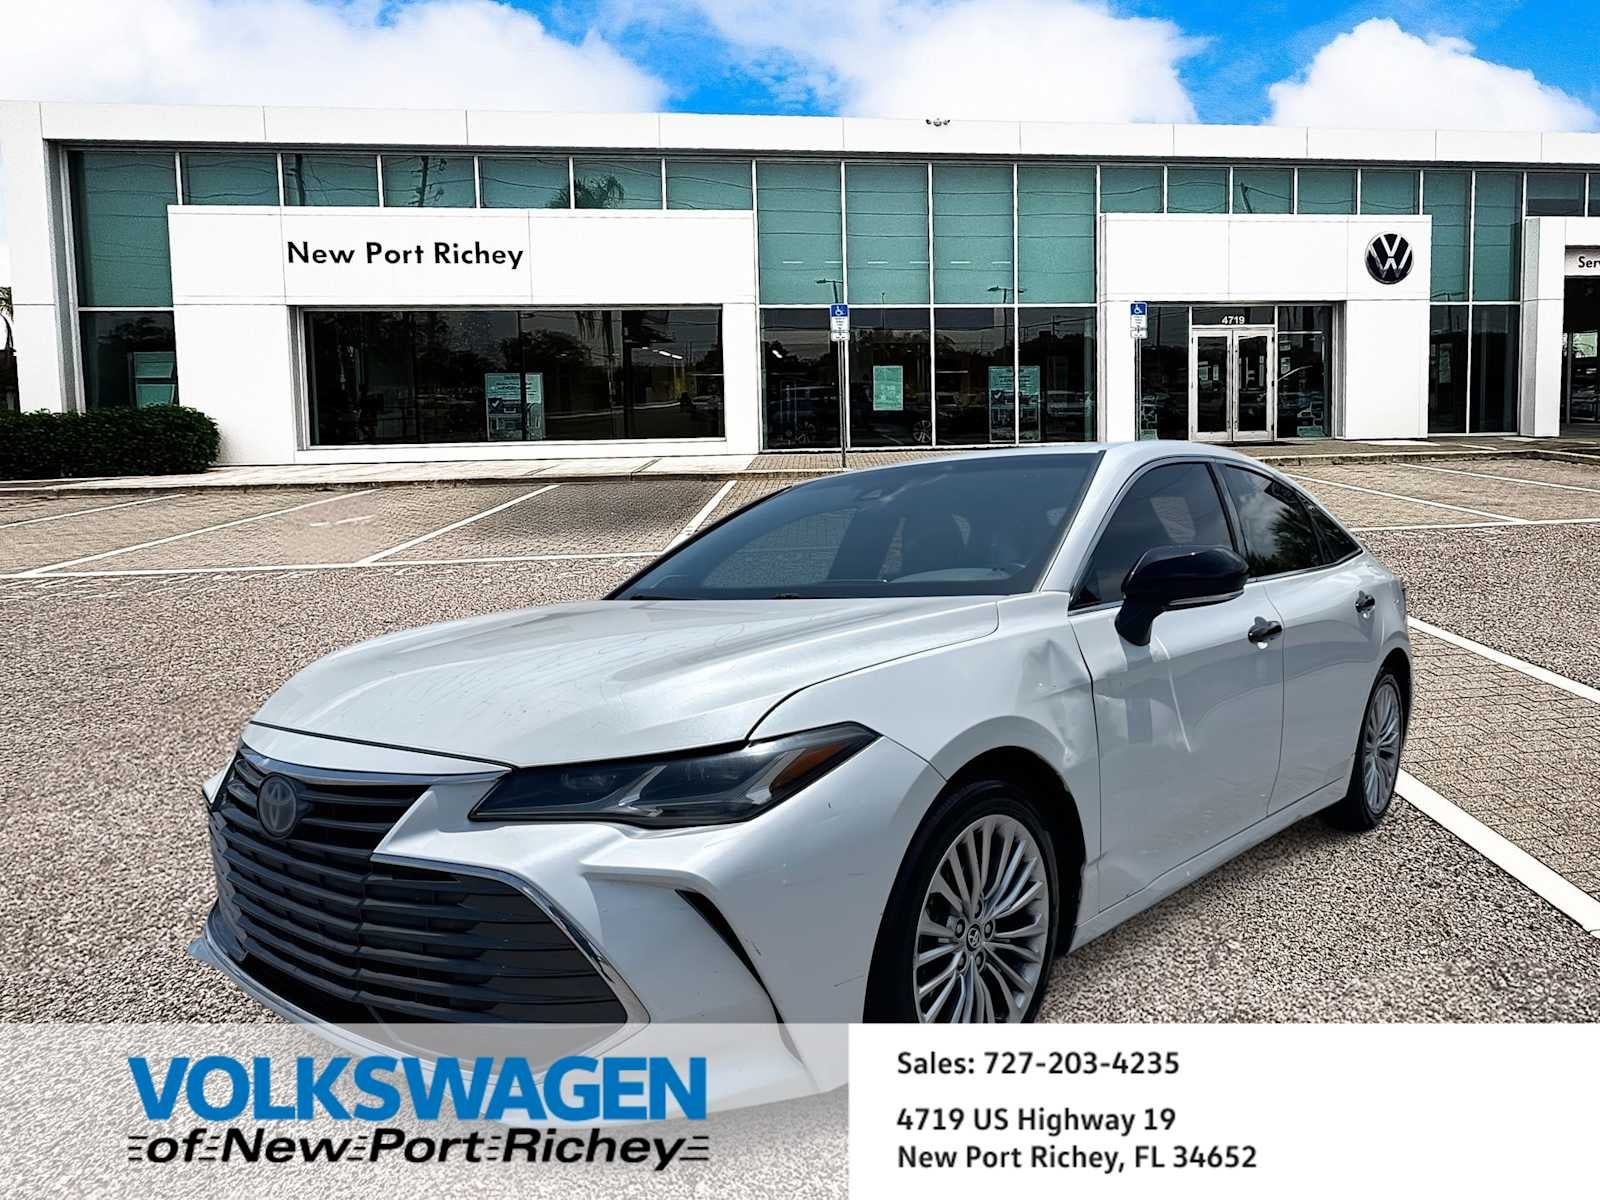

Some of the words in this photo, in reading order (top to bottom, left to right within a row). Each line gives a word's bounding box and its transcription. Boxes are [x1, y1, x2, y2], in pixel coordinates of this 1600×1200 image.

[287, 241, 356, 264] New
[366, 241, 425, 264] Port
[434, 240, 524, 270] Richey
[1366, 232, 1413, 284] VW
[1577, 255, 1600, 268] Ser
[1221, 315, 1246, 325] 4719
